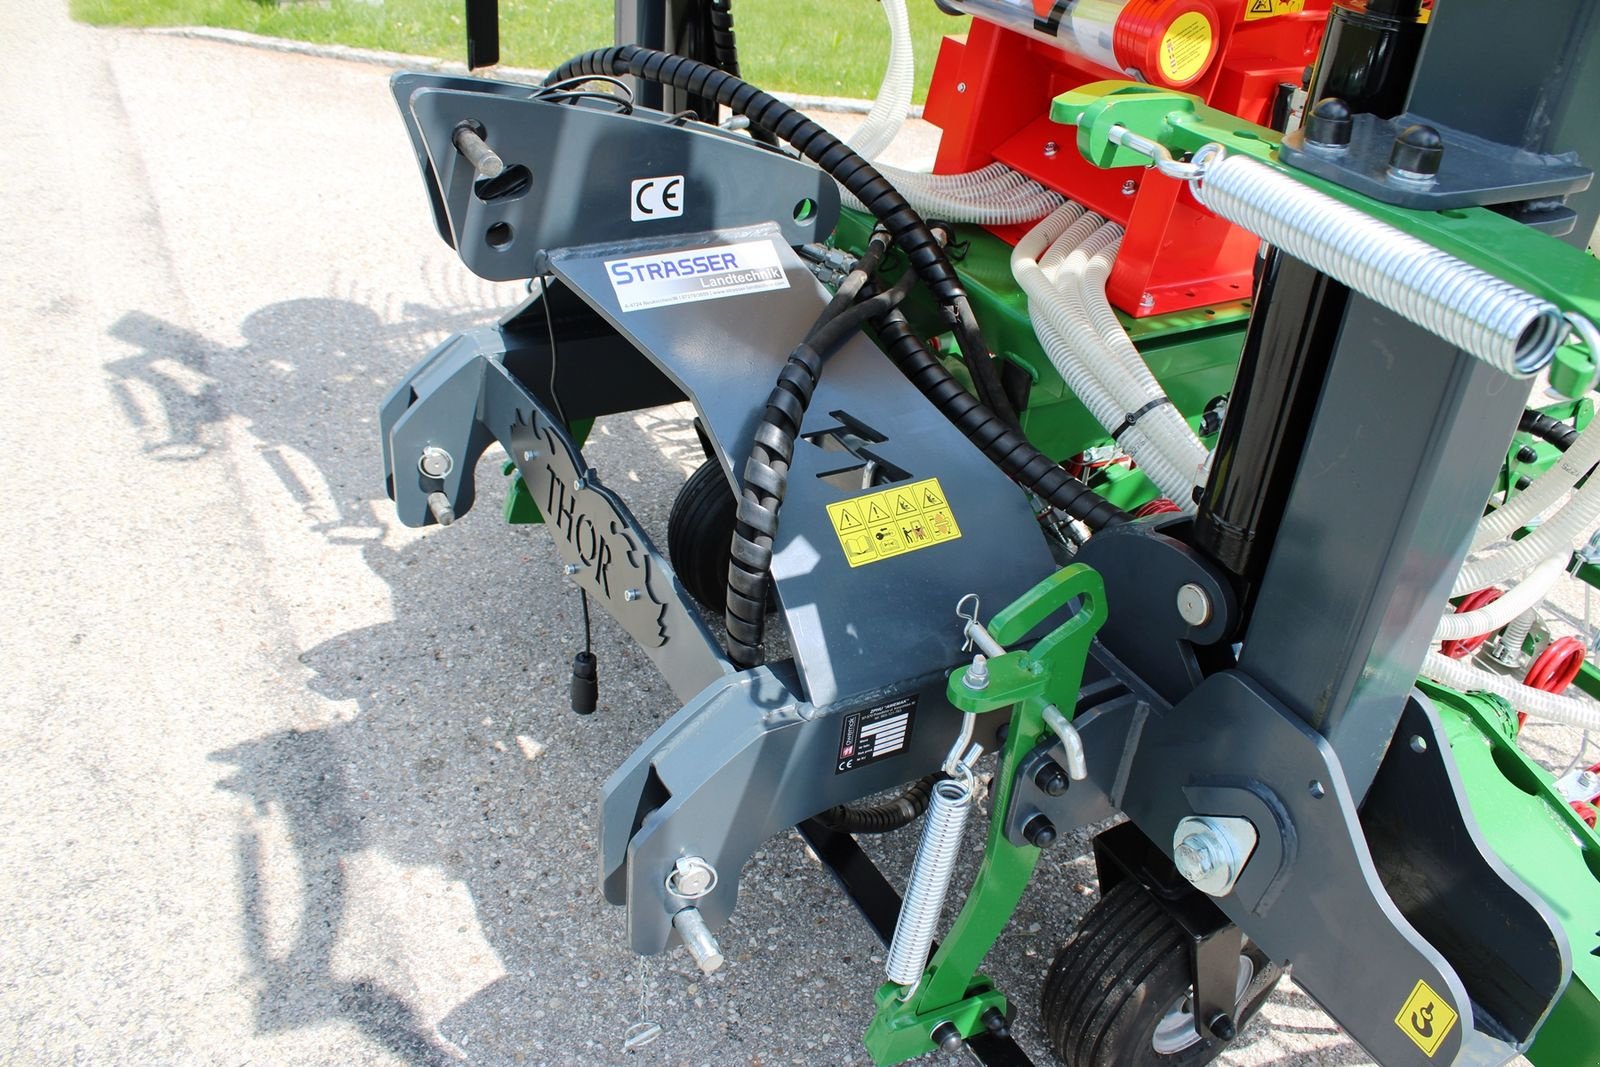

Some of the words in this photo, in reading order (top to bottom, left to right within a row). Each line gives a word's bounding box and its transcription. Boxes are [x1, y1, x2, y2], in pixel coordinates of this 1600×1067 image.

[636, 179, 680, 214] CE
[611, 252, 739, 285] STRASSER
[699, 266, 782, 289] Landtechnik
[546, 464, 611, 600] THOR
[838, 759, 853, 771] CE
